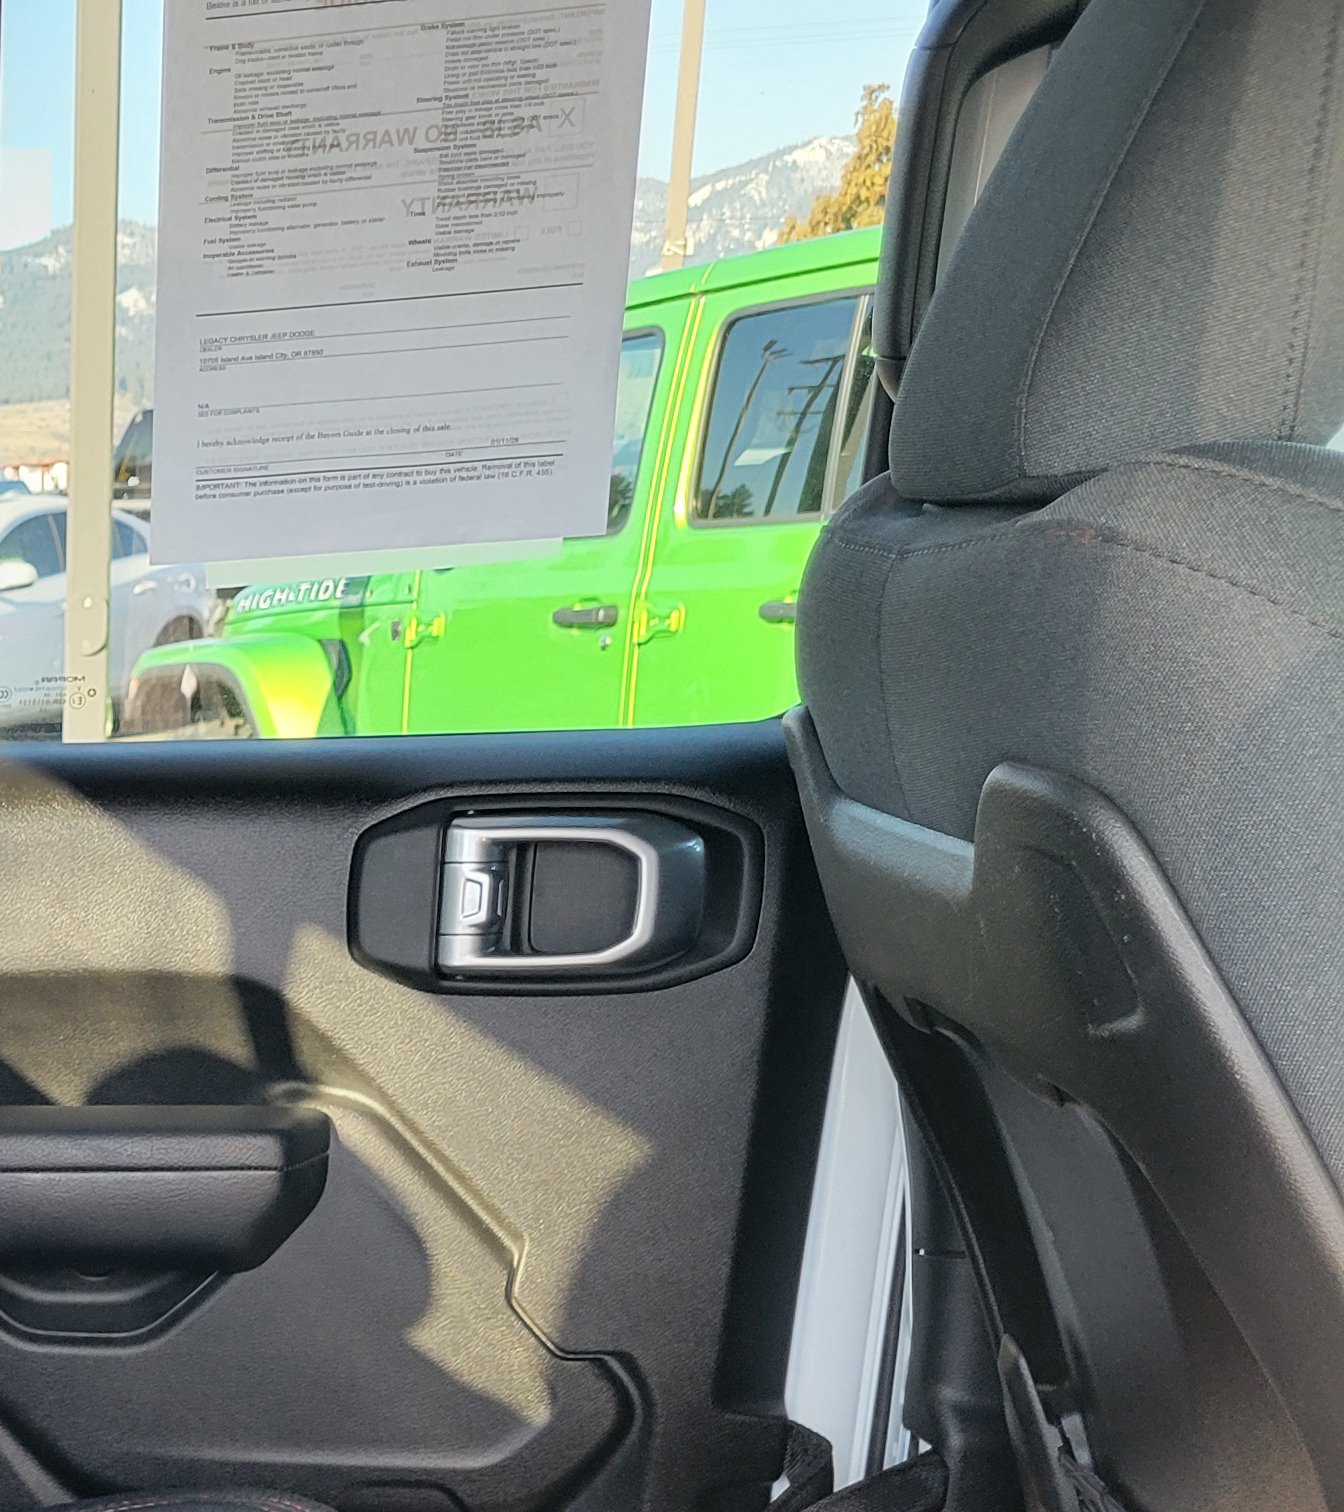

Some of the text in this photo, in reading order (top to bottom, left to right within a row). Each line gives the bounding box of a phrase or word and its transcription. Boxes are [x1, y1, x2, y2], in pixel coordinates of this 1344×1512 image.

[199, 330, 315, 345] LEGACY CHRYSLER JEEP DODGE
[220, 355, 239, 363] Island
[254, 352, 274, 360] Island
[275, 352, 288, 360] City,
[291, 350, 302, 358] OR
[201, 439, 224, 448] hereby
[226, 436, 270, 446] acknowledge
[271, 434, 294, 443] receipt
[296, 433, 304, 441] of
[305, 432, 315, 440] the
[343, 430, 364, 438] Guide
[386, 426, 411, 435] closing
[413, 424, 422, 433] of
[422, 424, 436, 432] this
[244, 480, 257, 488] The
[258, 478, 296, 487] information
[308, 475, 321, 483] this
[322, 473, 339, 482] form
[347, 473, 361, 481] part
[362, 471, 370, 479] of
[371, 471, 384, 480] any
[386, 470, 414, 479] contract
[424, 468, 438, 477] buy
[439, 467, 452, 475] this
[481, 462, 513, 471] Removal
[514, 461, 522, 469] of
[523, 460, 536, 468] this
[537, 459, 555, 467] label
[195, 492, 217, 500] before
[218, 490, 252, 499] consumer
[253, 488, 285, 497] purchase
[313, 484, 323, 492] for
[324, 482, 352, 491] purpose
[353, 481, 361, 489] of
[419, 476, 448, 485] violation
[449, 475, 457, 483] of
[458, 474, 482, 482] federal
[237, 577, 348, 614] HIGH TIDE
